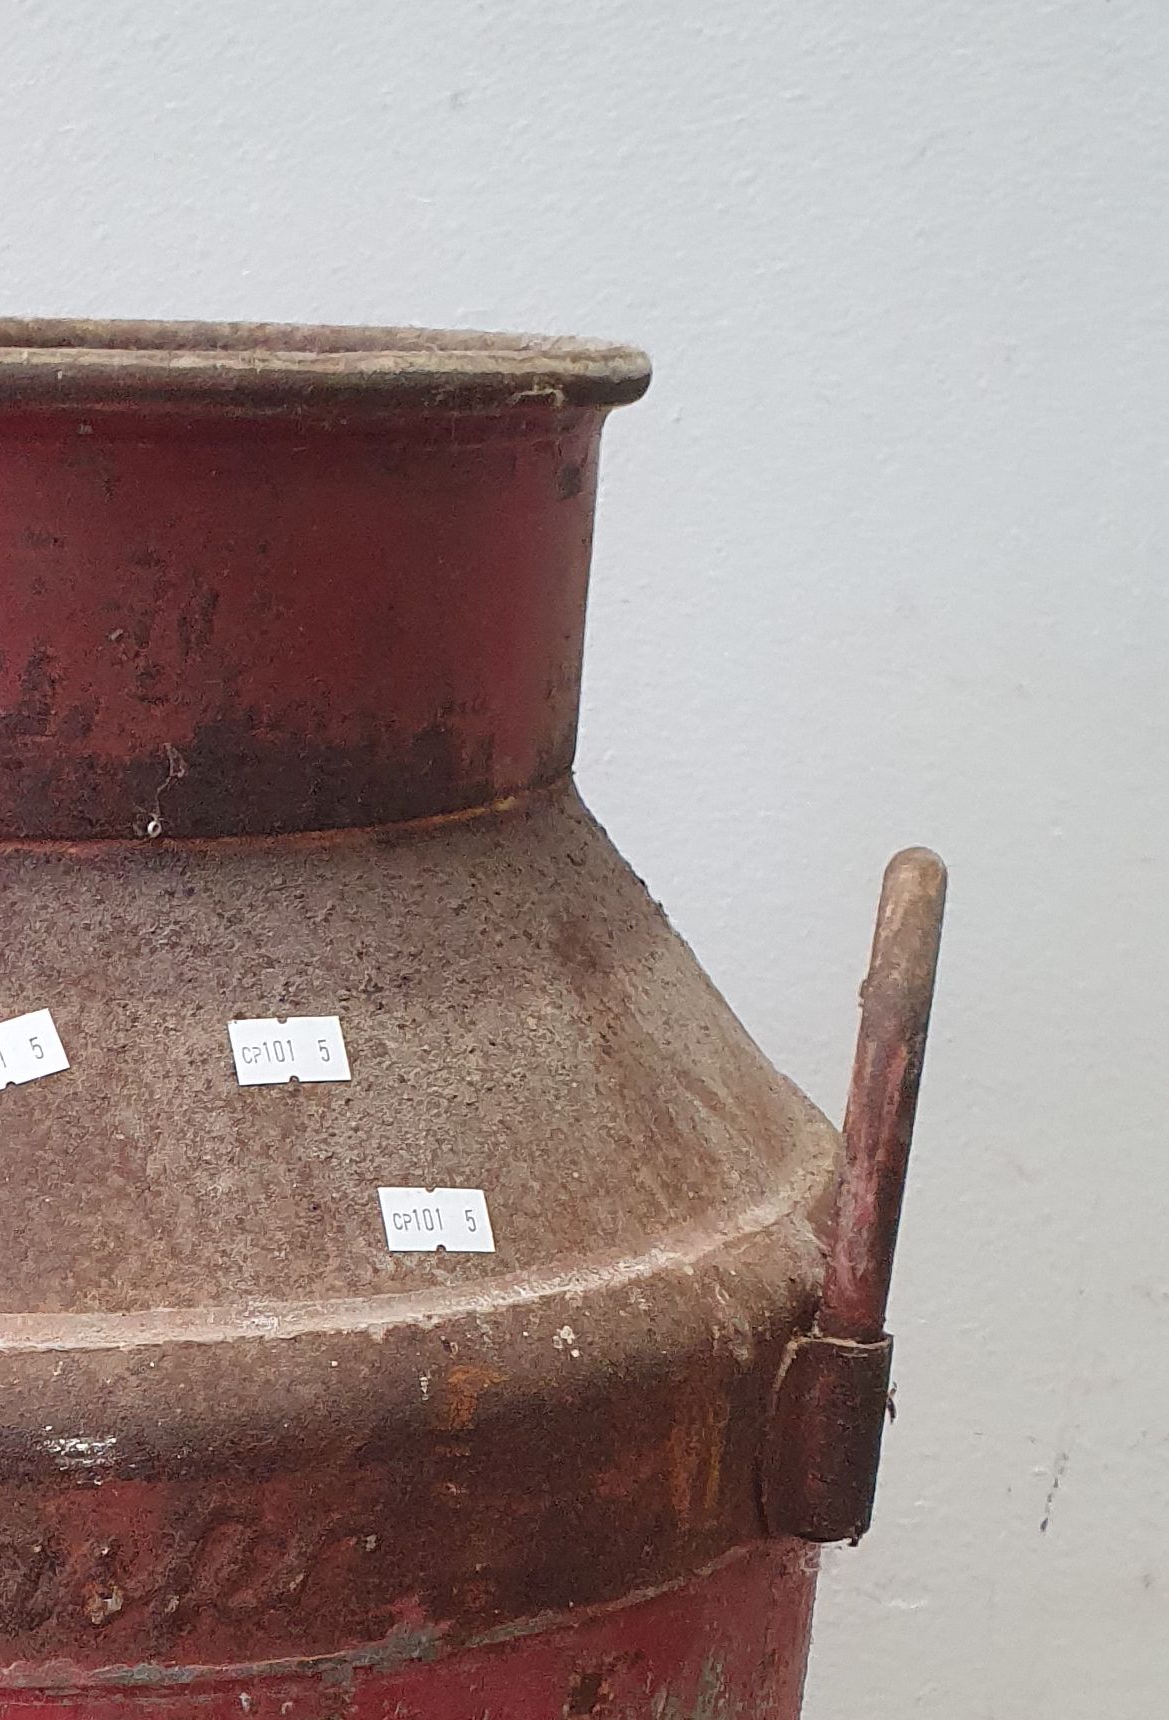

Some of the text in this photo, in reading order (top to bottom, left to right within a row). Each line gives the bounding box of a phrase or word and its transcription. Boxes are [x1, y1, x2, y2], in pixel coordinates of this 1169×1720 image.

[28, 1036, 45, 1060] 5
[241, 1039, 331, 1064] CP101 5
[392, 1207, 477, 1233] CP101 5
